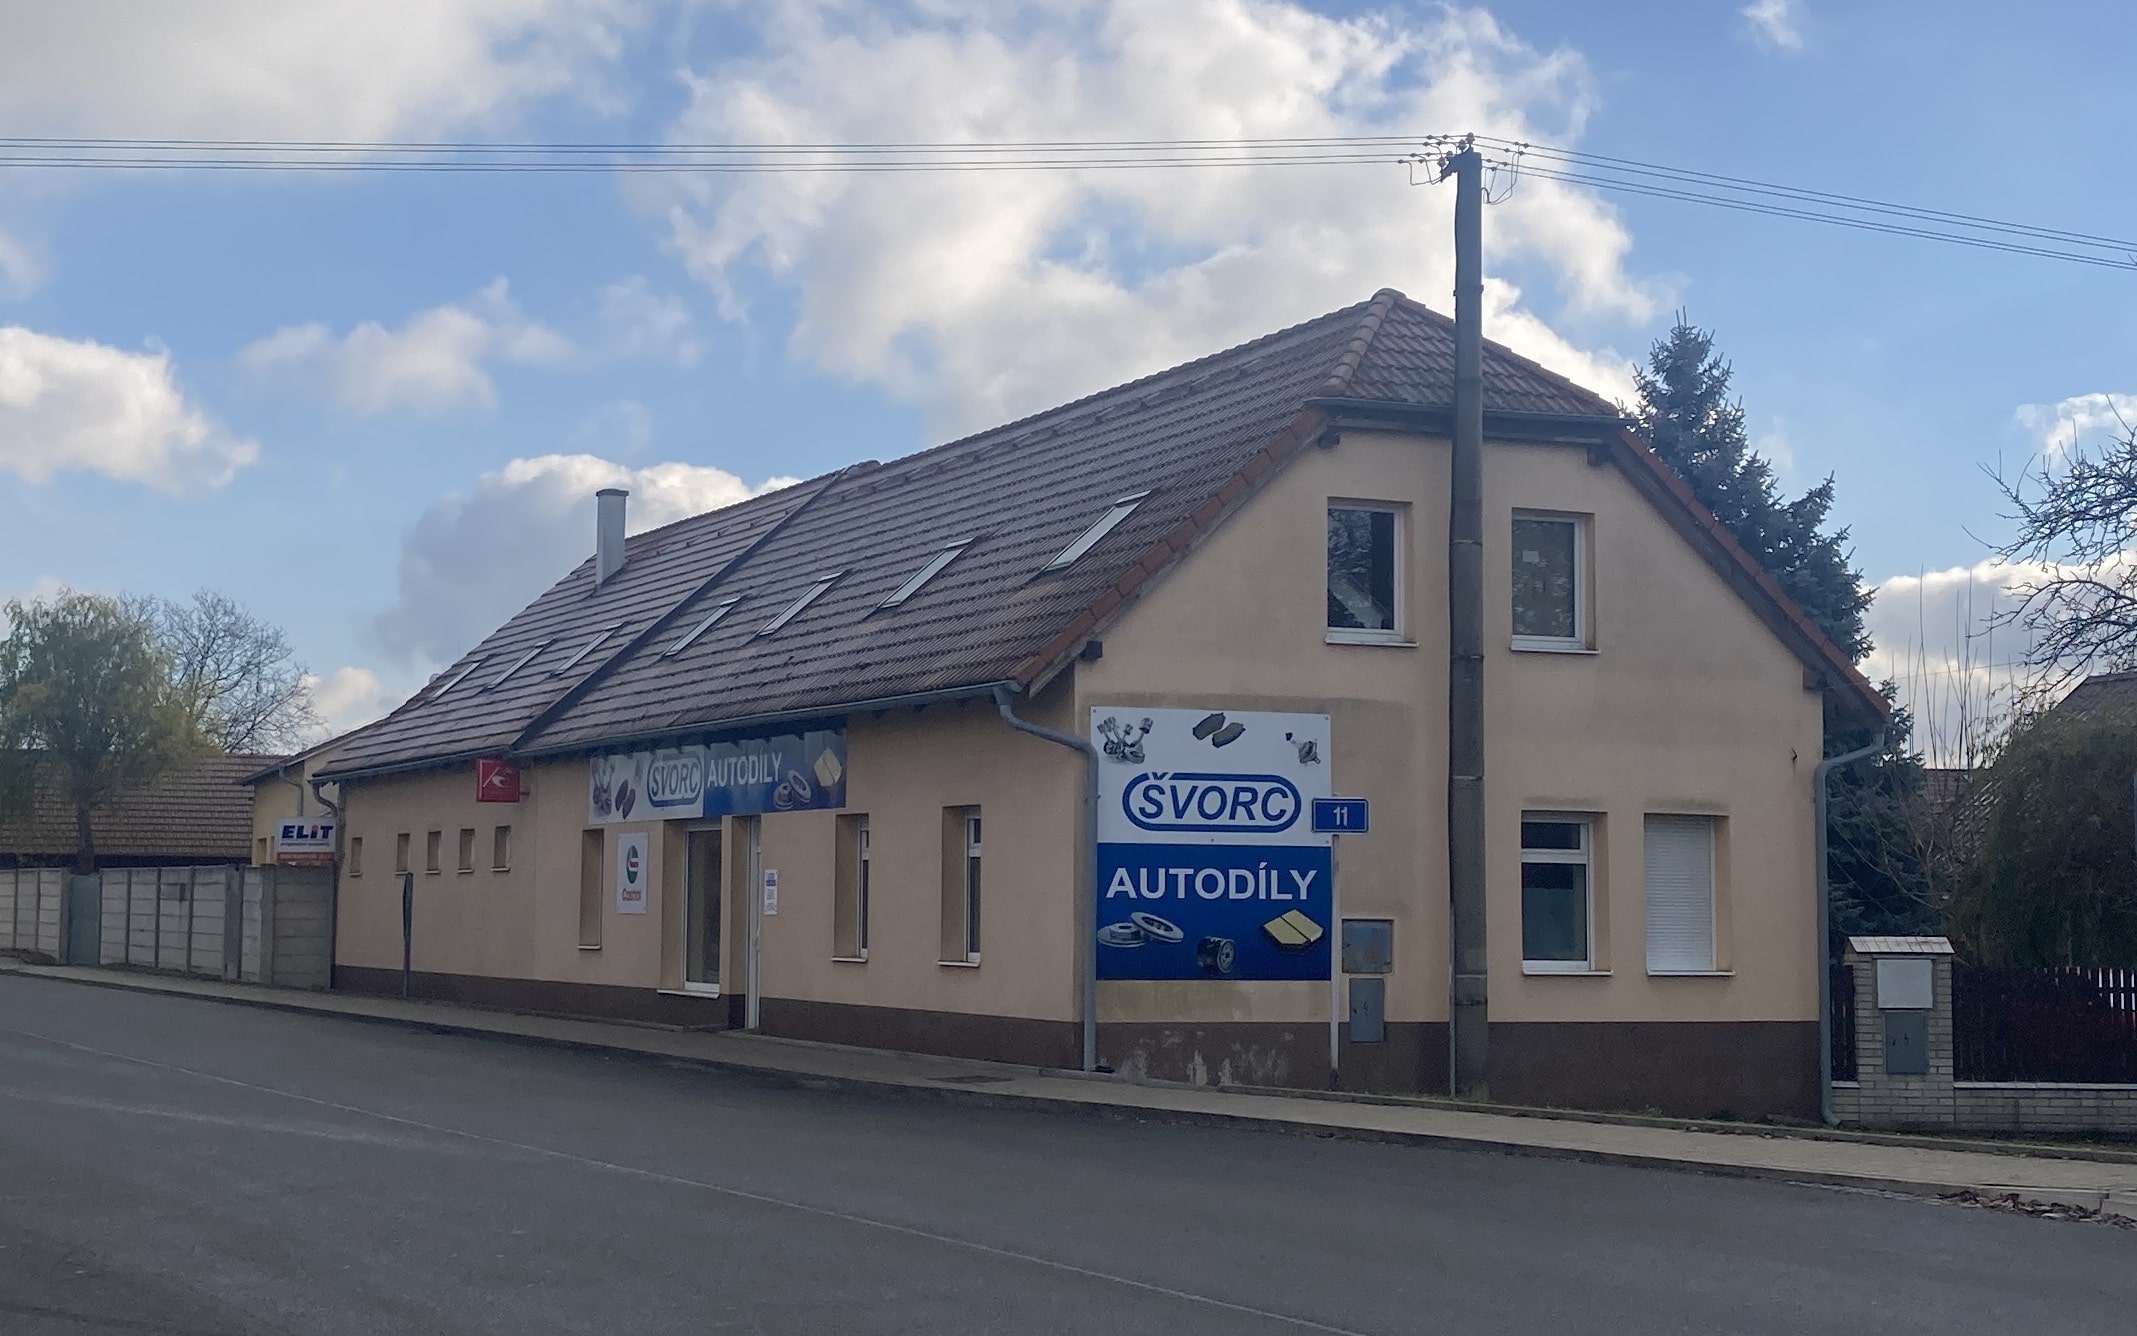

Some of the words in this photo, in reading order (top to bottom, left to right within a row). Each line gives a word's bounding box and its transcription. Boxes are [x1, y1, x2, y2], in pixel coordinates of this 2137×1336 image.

[706, 748, 782, 789] AUTODÍLY
[1138, 771, 1290, 822] ŠVORC
[1332, 806, 1349, 827] 11
[1105, 861, 1318, 901] AUTODÍLY
